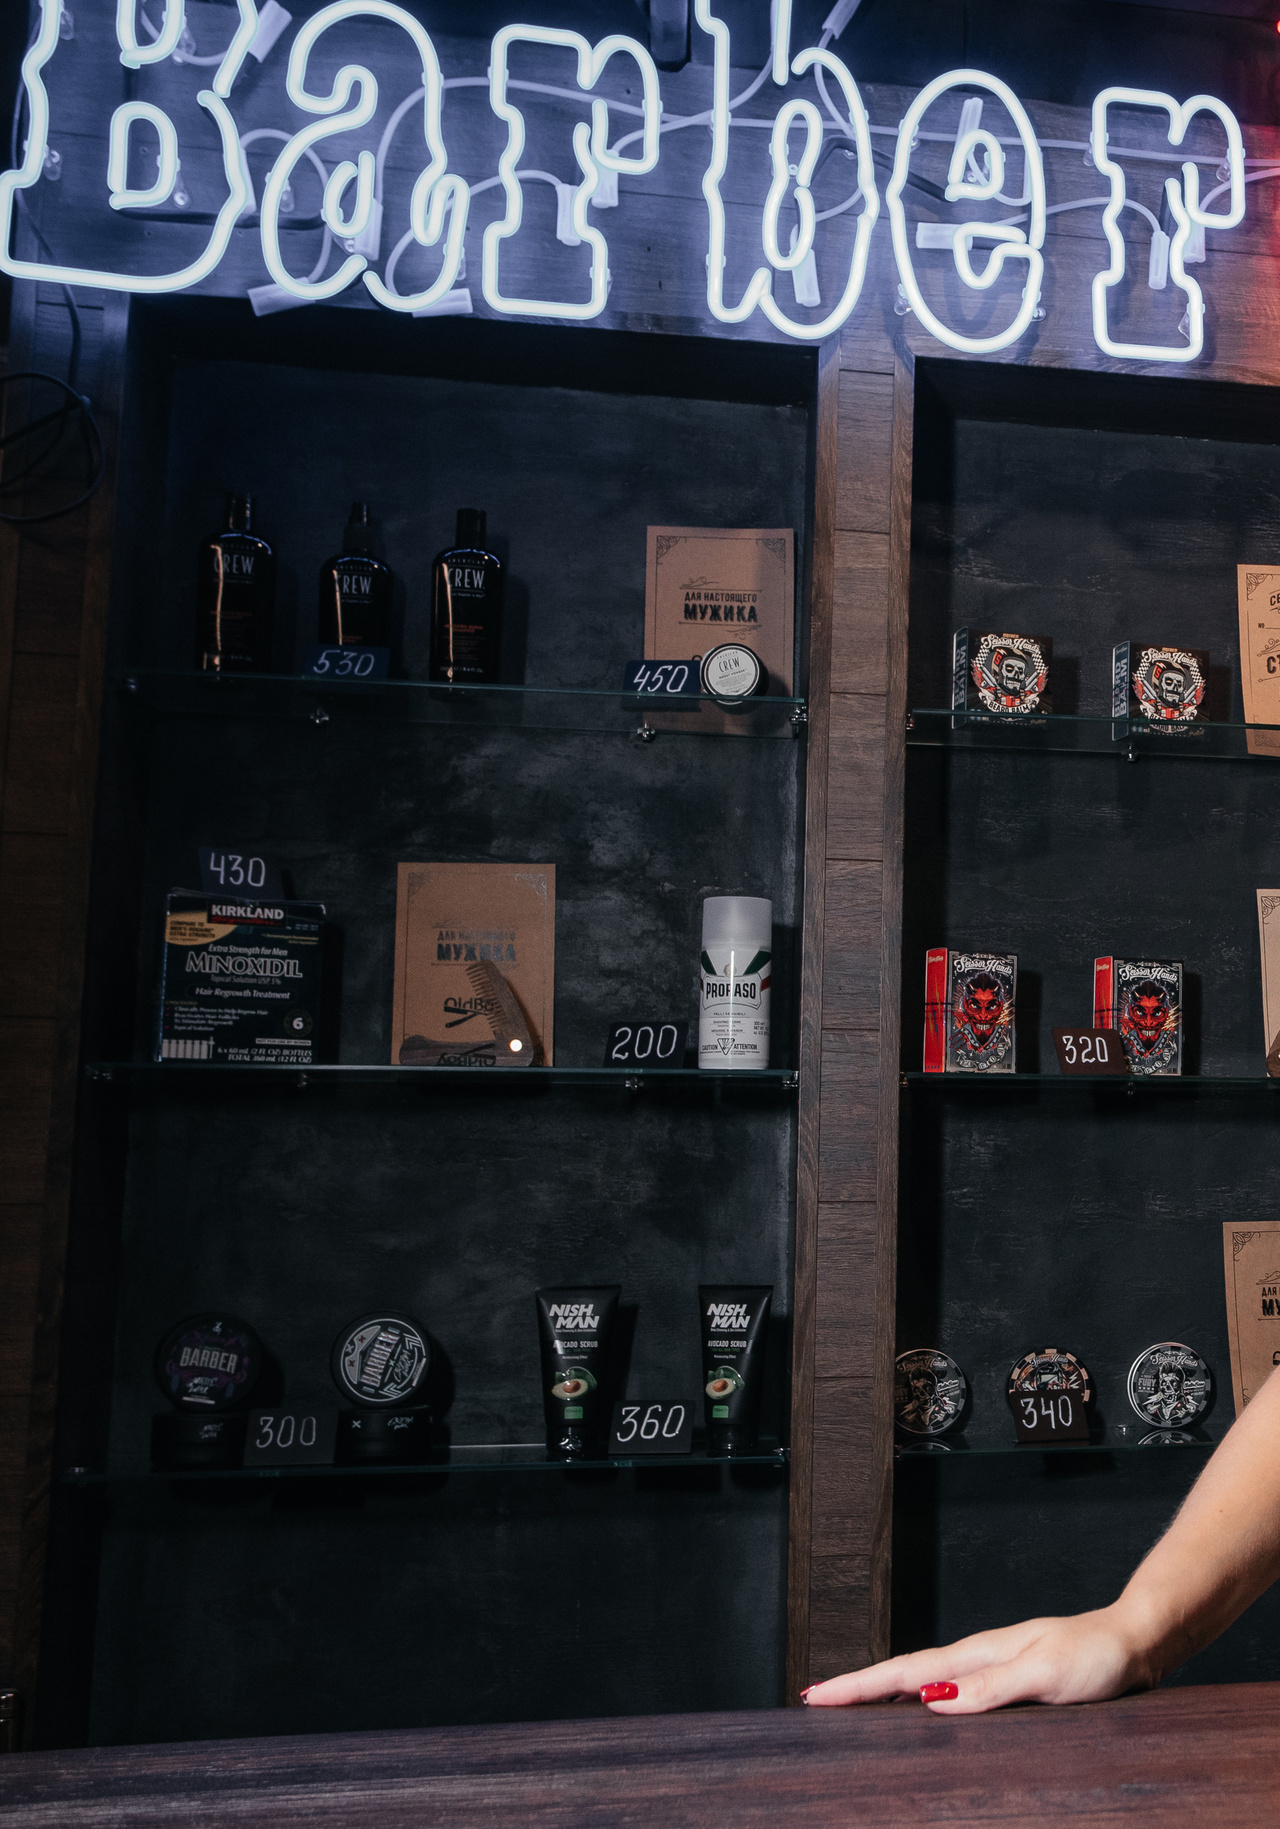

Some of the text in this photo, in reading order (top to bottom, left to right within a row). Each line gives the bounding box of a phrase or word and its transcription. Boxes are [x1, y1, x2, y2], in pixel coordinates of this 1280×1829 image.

[0, 0, 1246, 361] Barber
[684, 591, 757, 604] ДЛЯ НАСТОЯЩЕГО
[683, 603, 758, 623] МУЖИКА
[313, 649, 375, 676] 530
[719, 657, 740, 672] CREW
[633, 664, 689, 693] 450
[209, 852, 266, 887] 430
[211, 904, 285, 920] KIRKLAND
[208, 944, 288, 956] Extra Strength for Men
[437, 942, 517, 961] МУЖИКА
[185, 951, 303, 978] MINOXIDIL
[953, 956, 985, 973] Scissor
[985, 959, 1013, 974] Hands
[1118, 965, 1178, 981] Scissor Hands
[210, 975, 231, 984] Topical
[231, 976, 257, 984] Solution
[195, 986, 291, 1000] Hair Regrowth Treatment
[292, 1018, 304, 1030] 6
[612, 1025, 678, 1060] 200
[1062, 1035, 1108, 1064] 320
[1261, 1286, 1277, 1297] ДЛЯ
[555, 1316, 600, 1328] MAN
[711, 1315, 751, 1328] MAN
[707, 1340, 747, 1348] AVOCADO SCRUB
[180, 1347, 238, 1374] BARBER
[1138, 1378, 1156, 1387] FURY
[1020, 1395, 1072, 1429] 340
[256, 1416, 316, 1448] 300
[617, 1405, 685, 1442] 360
